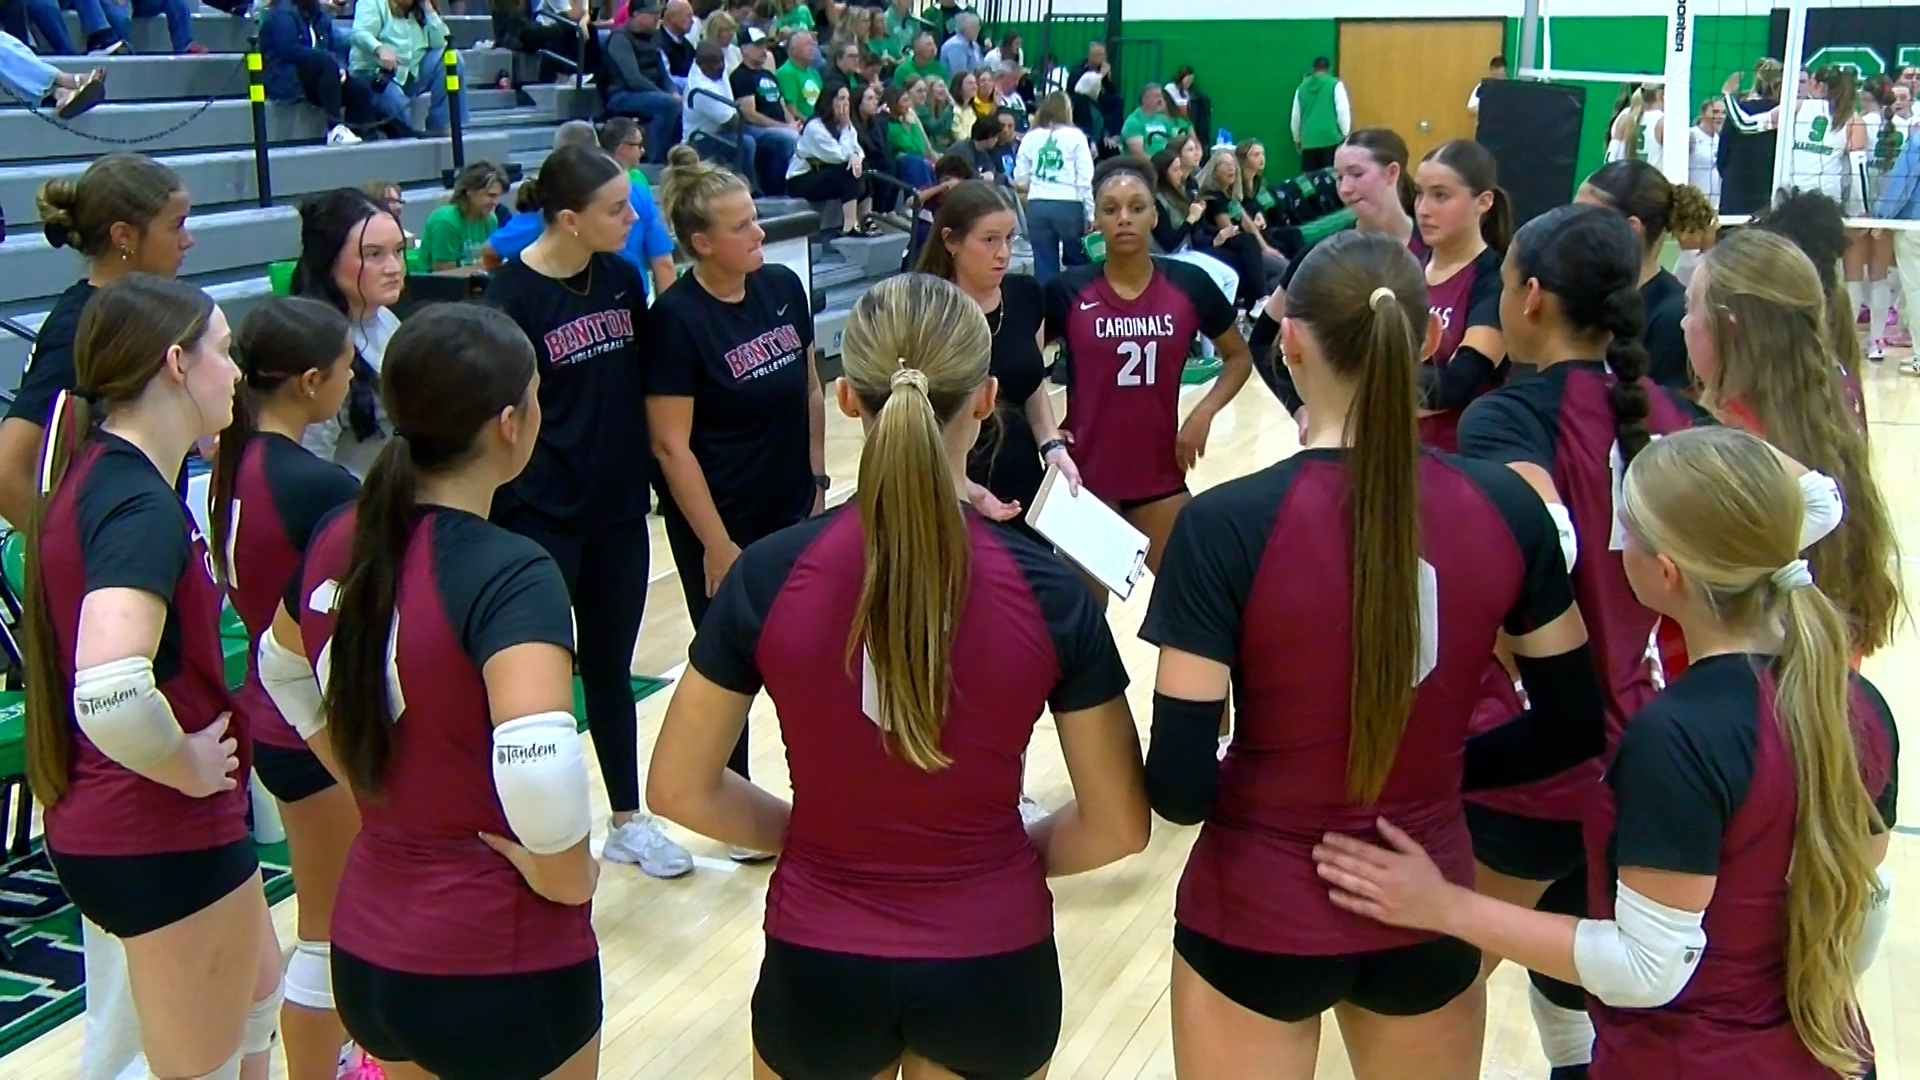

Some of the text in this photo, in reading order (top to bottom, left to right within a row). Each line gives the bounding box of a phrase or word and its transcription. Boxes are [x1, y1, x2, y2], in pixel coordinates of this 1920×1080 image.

[543, 309, 634, 363] BENTON
[1095, 313, 1174, 338] CARDINALS
[724, 323, 802, 379] BENTON
[1116, 340, 1157, 387] 21
[77, 687, 139, 716] Tandem
[496, 743, 557, 765] Tandem
